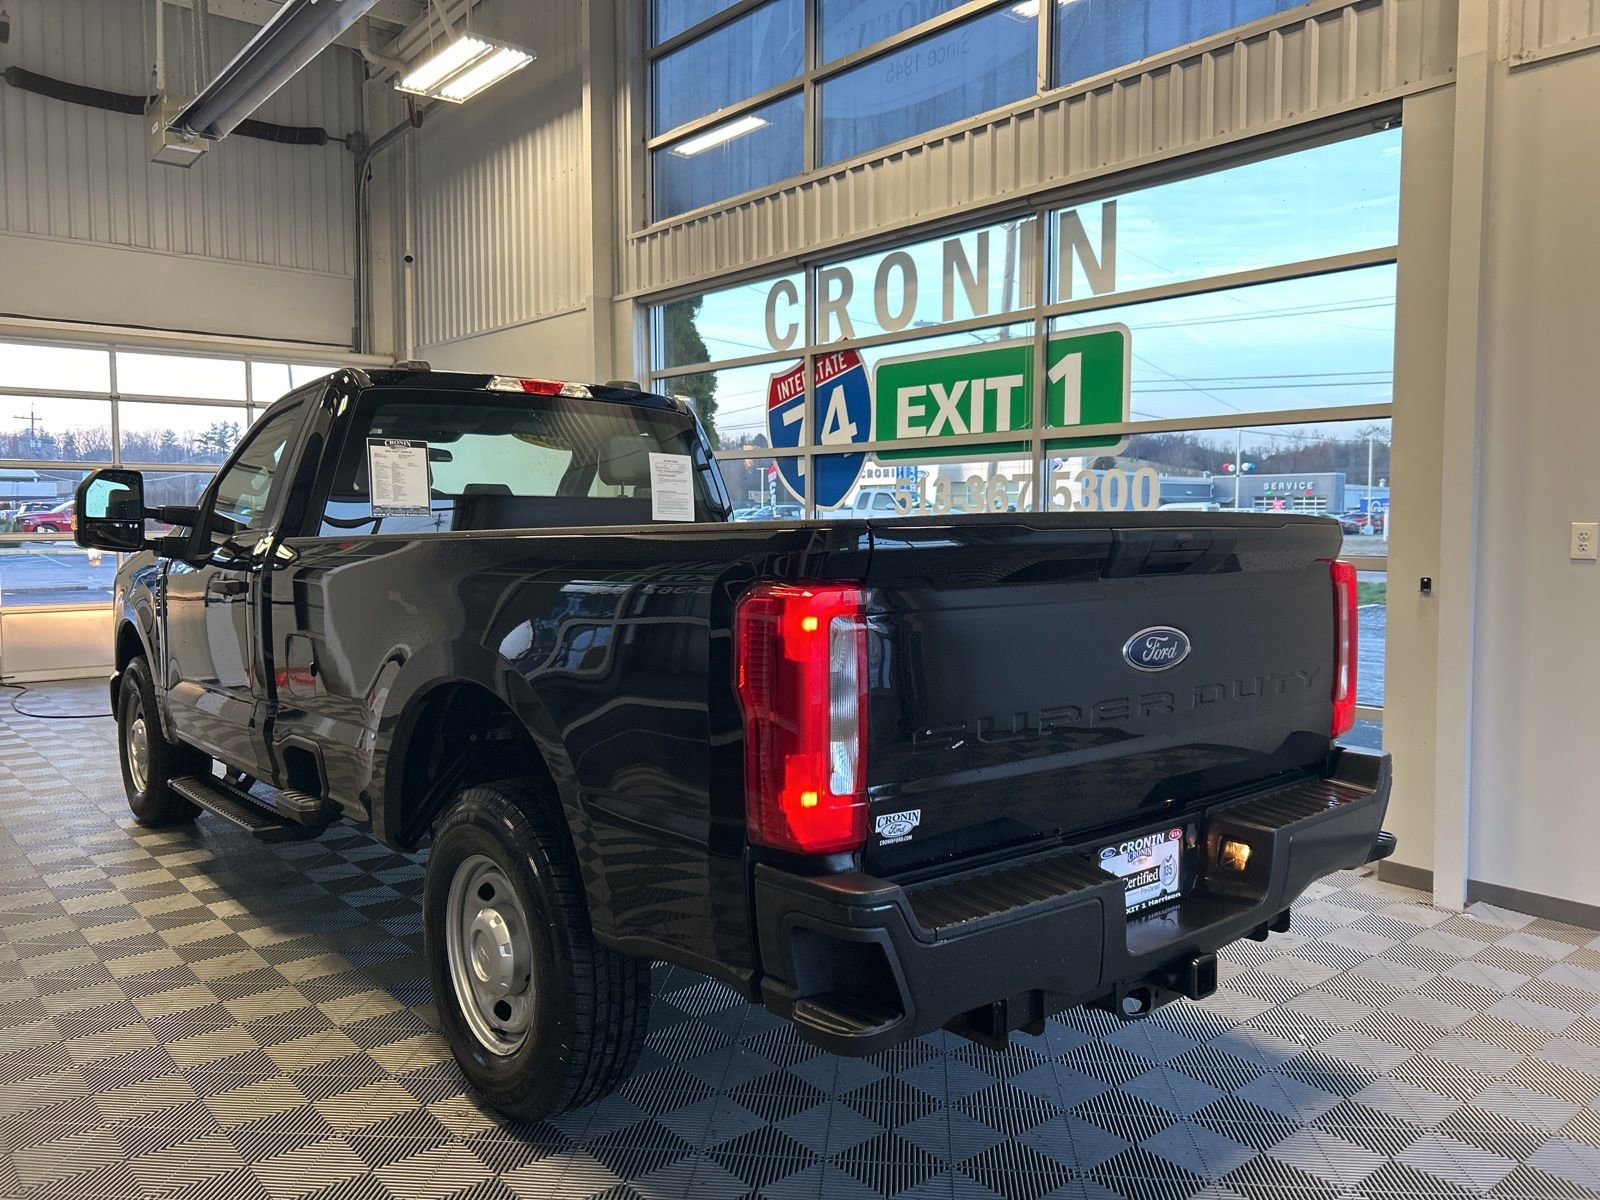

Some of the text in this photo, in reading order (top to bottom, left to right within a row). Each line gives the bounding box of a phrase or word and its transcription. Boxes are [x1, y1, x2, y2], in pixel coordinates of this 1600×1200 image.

[765, 200, 1117, 351] CRONIN
[777, 351, 847, 402] INTETATE
[896, 353, 1083, 439] EXIT 1
[782, 384, 858, 477] 74
[1263, 481, 1313, 491] SERVICE
[1142, 636, 1179, 662] Ford
[912, 666, 1321, 755] SUPER DUTY
[877, 811, 919, 828] CRONIN
[1120, 832, 1165, 855] CRONIN
[1126, 904, 1140, 915] XIT
[1148, 892, 1181, 907] Harrison
